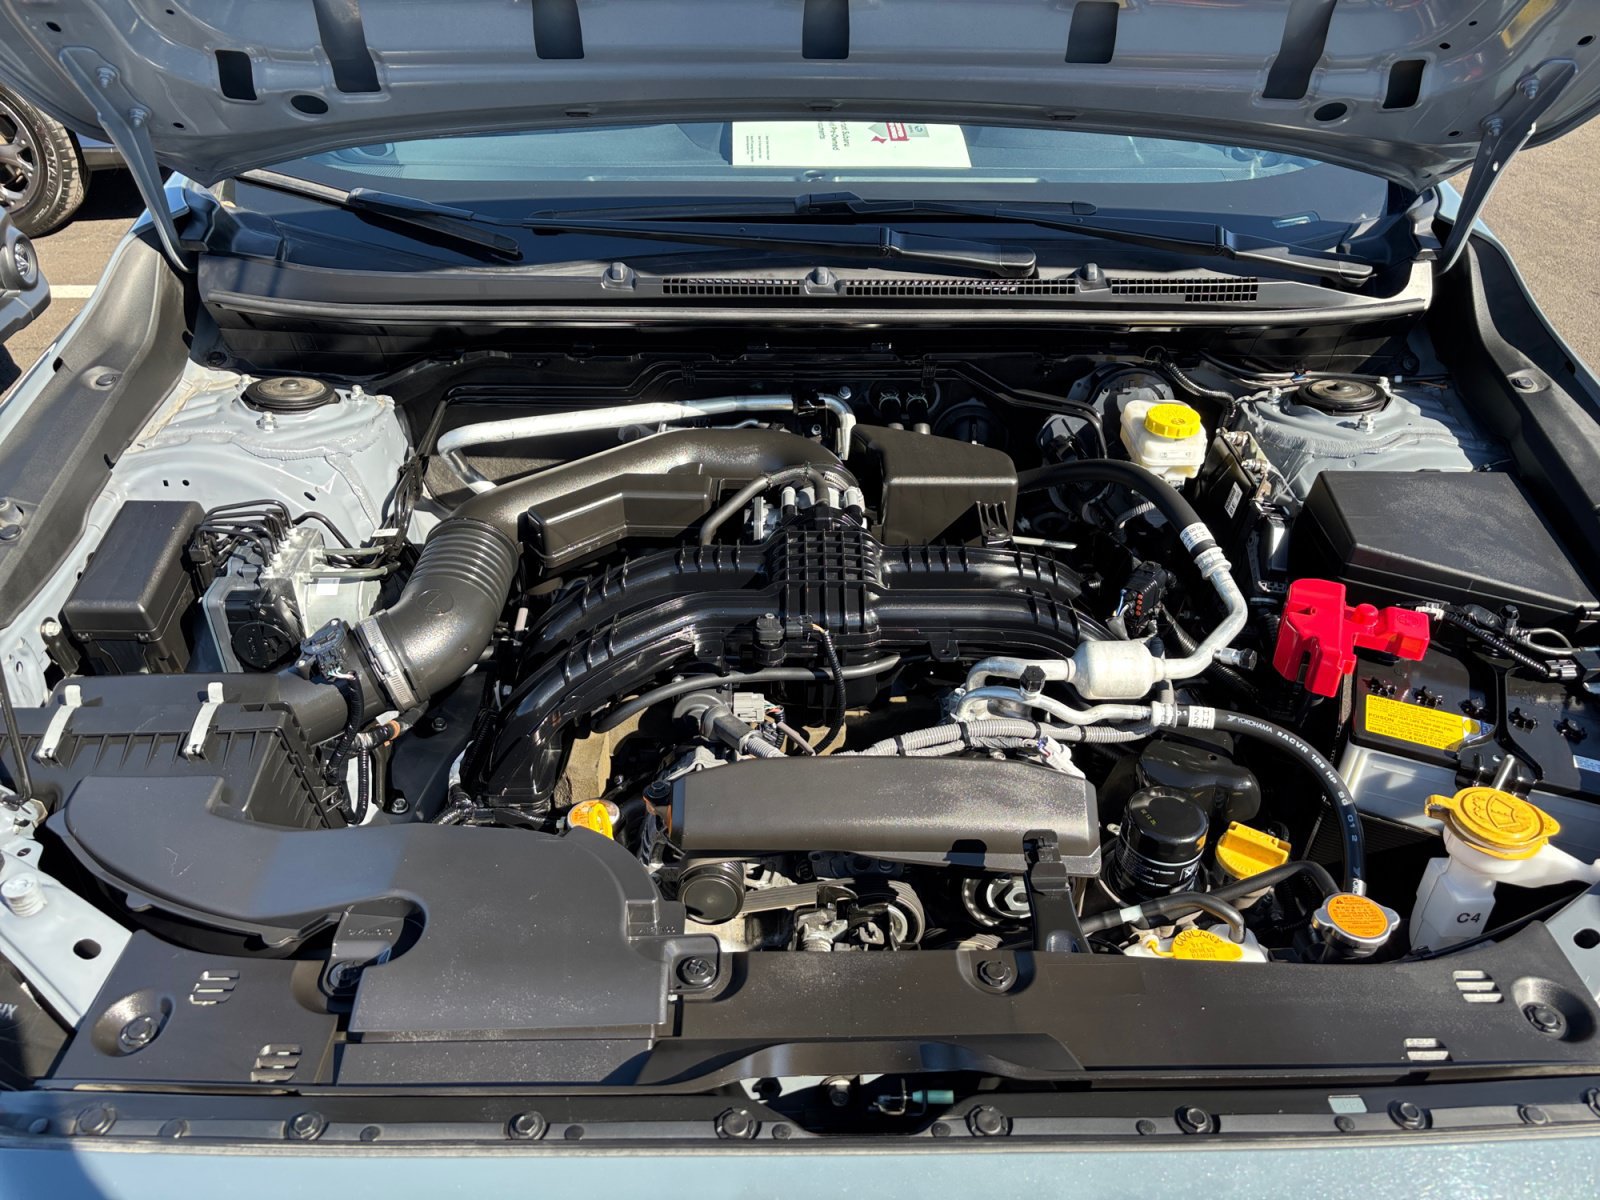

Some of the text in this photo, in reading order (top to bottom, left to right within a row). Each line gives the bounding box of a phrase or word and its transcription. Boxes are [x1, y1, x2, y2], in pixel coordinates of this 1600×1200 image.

[1368, 696, 1394, 705] DANGER
[1368, 712, 1393, 722] POISON
[1236, 718, 1273, 733] YOKOHAMA
[1326, 770, 1338, 784] HP
[1456, 912, 1481, 923] C4
